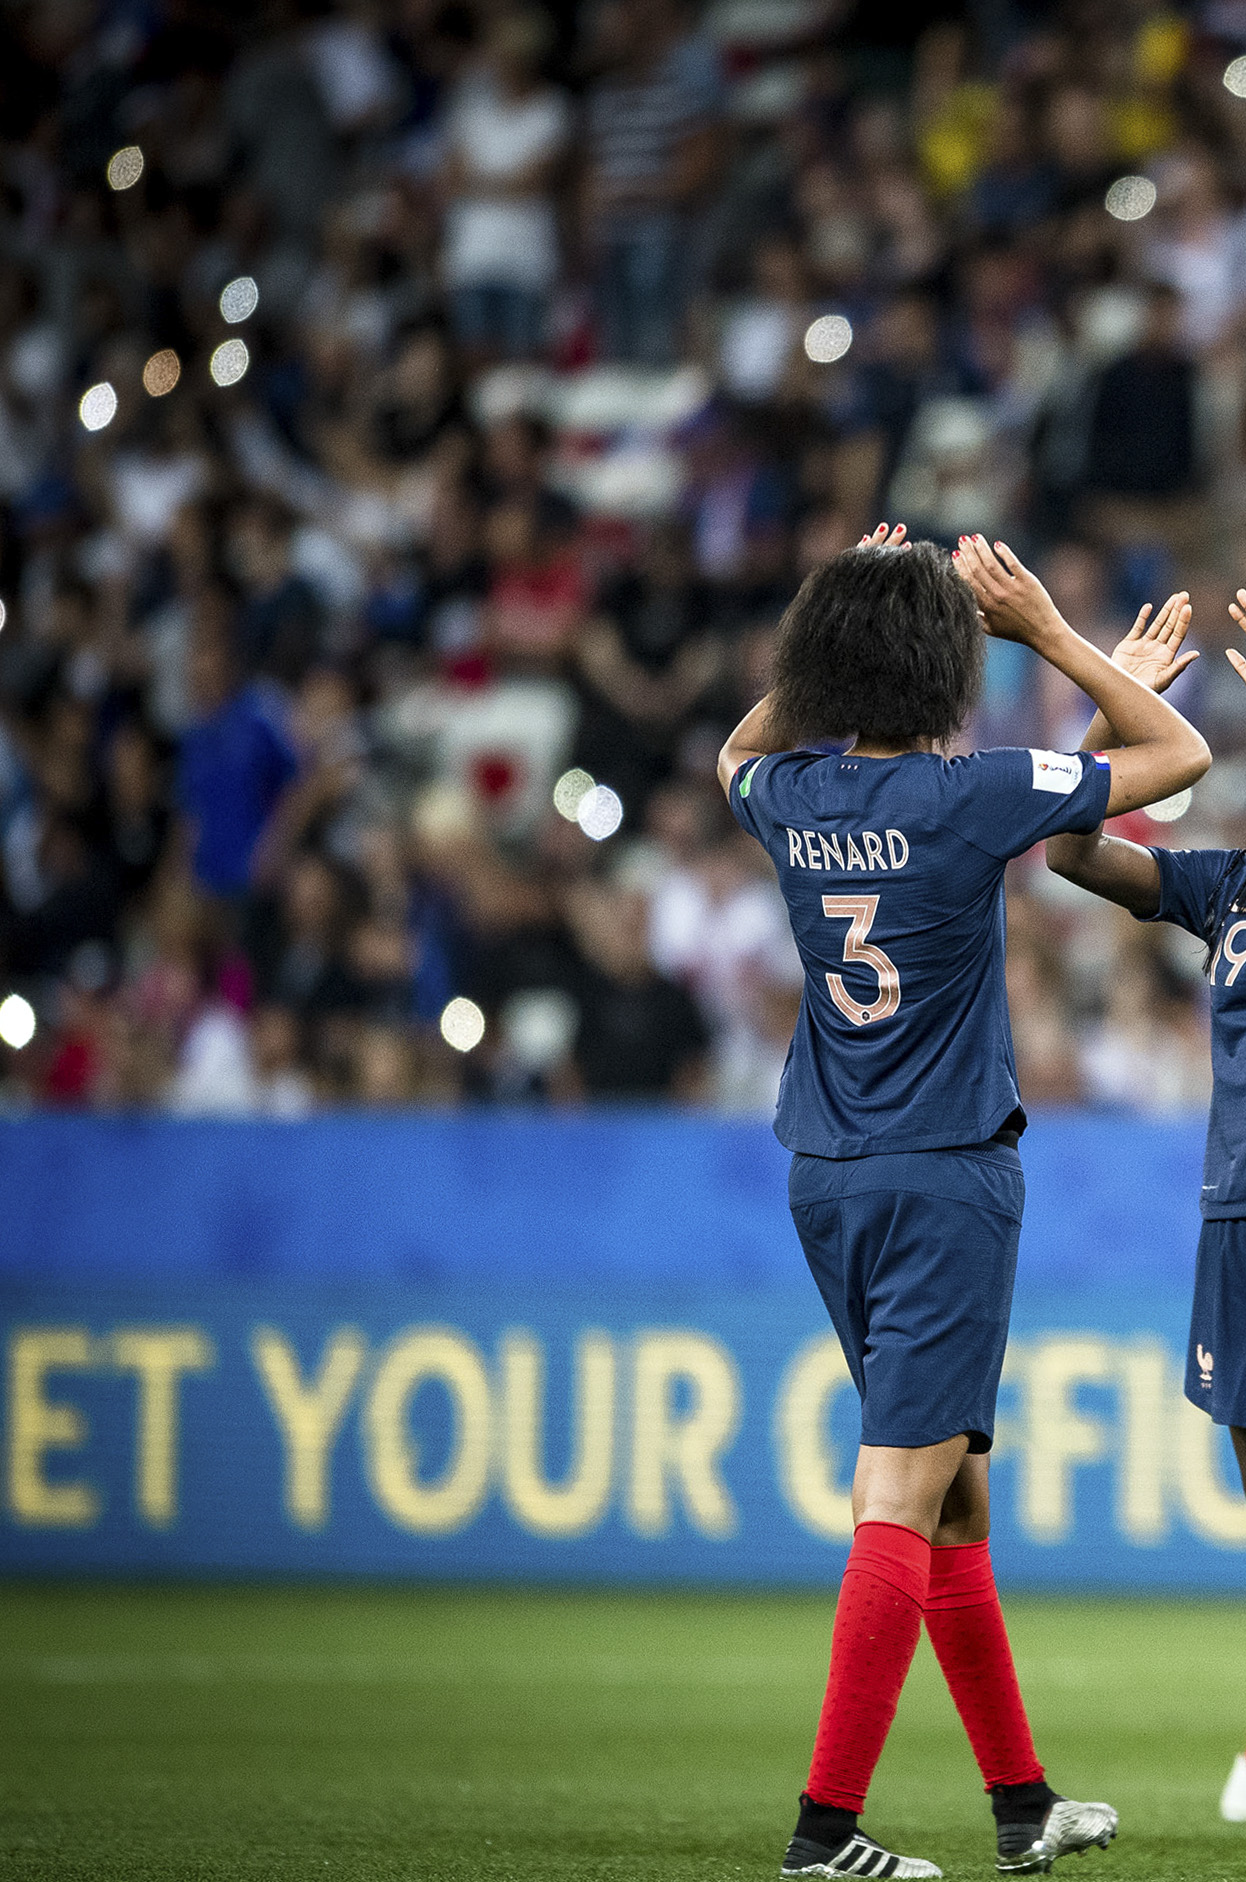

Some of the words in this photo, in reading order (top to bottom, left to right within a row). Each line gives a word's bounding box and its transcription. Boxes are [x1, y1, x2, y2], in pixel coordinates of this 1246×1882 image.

[786, 827, 909, 871] RENARD
[821, 894, 901, 1026] 3
[8, 1325, 214, 1530] ET
[250, 1323, 744, 1540] YOUR
